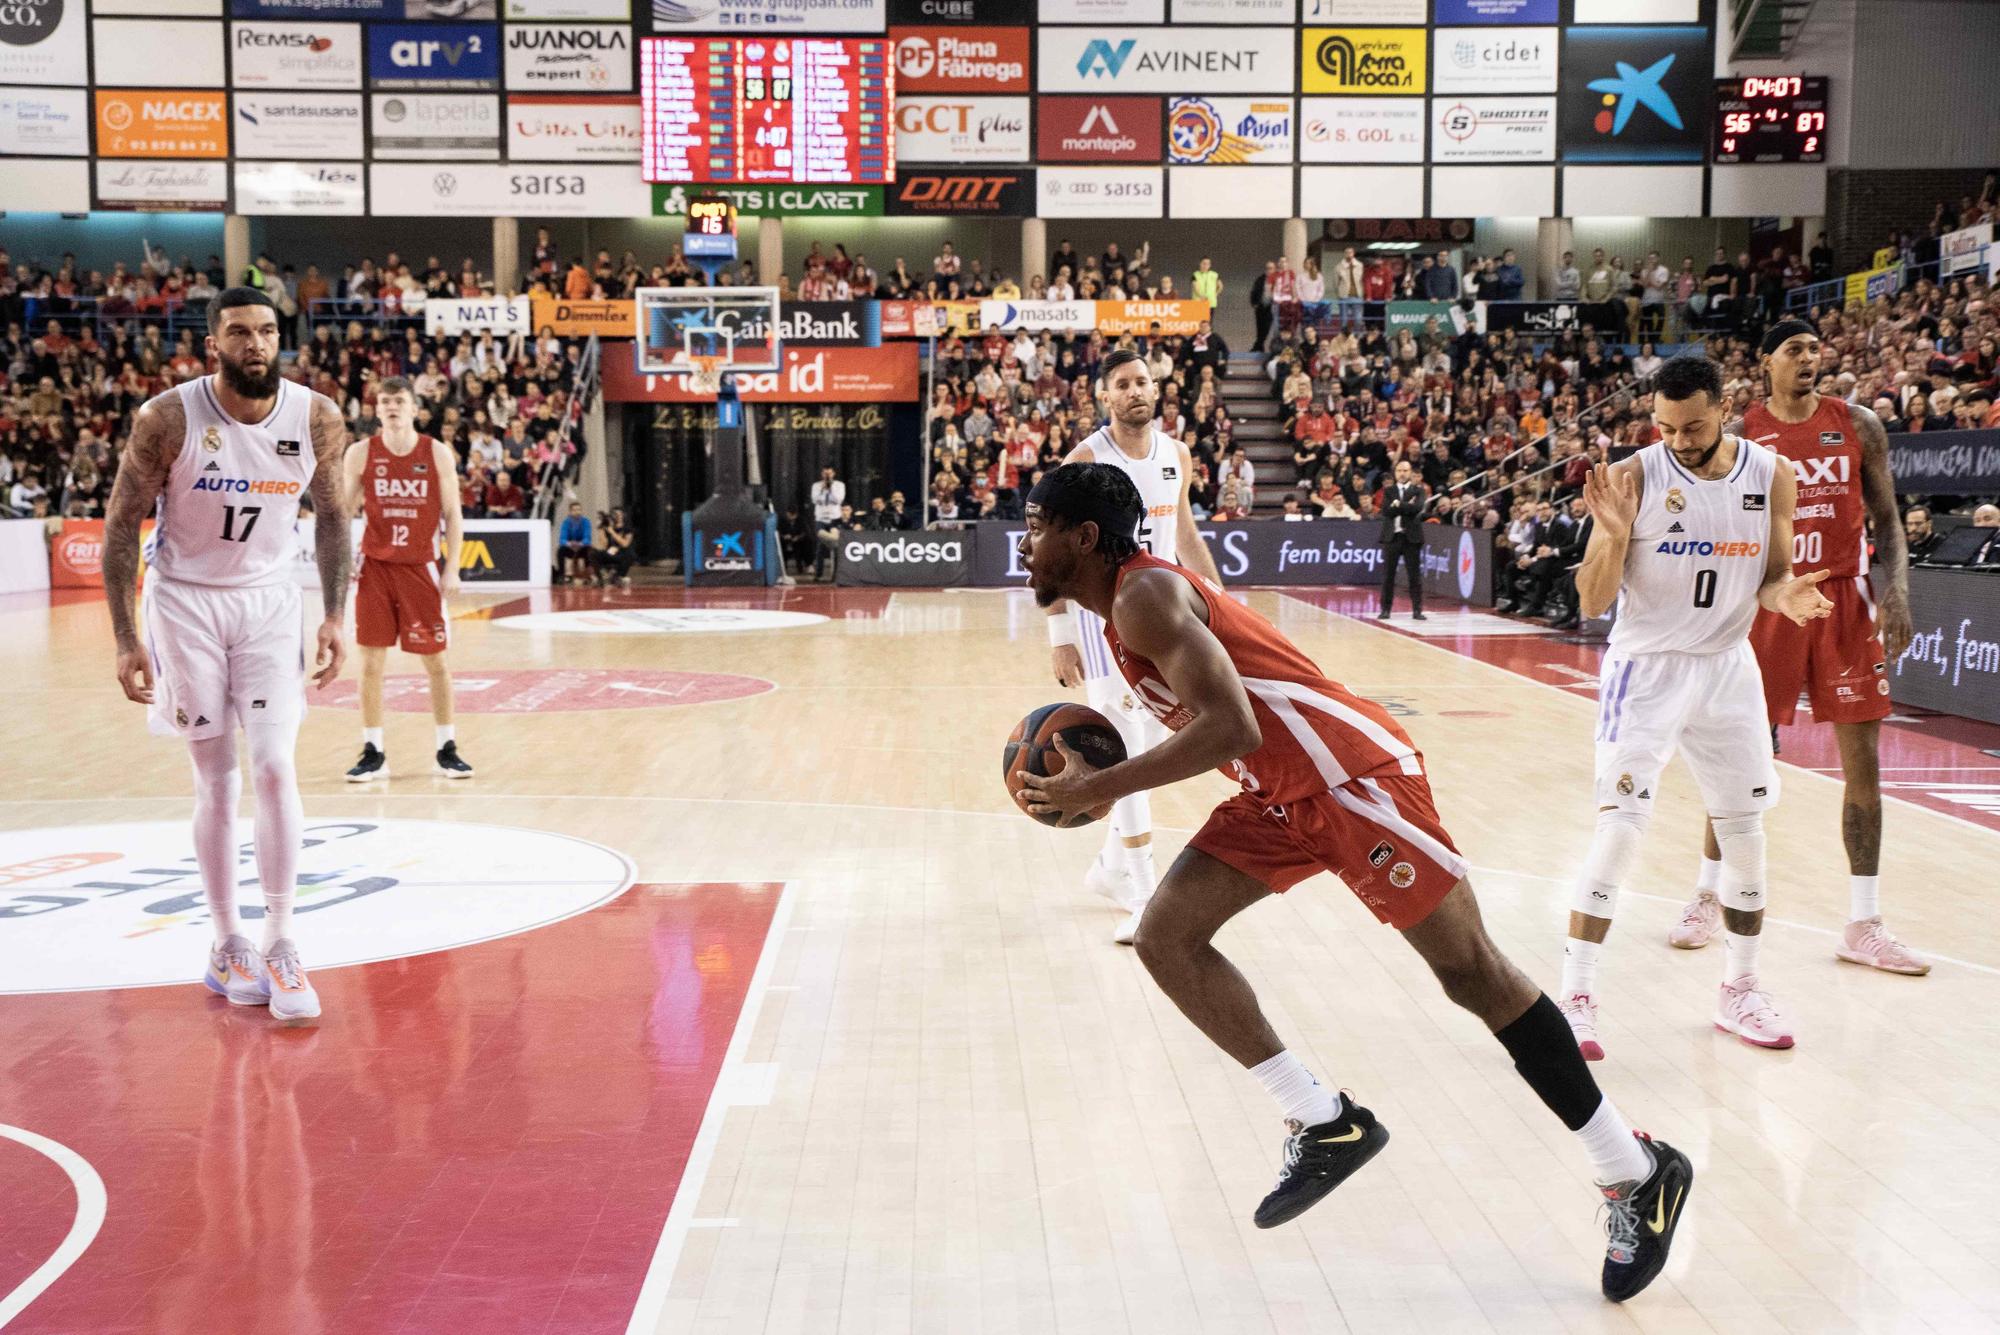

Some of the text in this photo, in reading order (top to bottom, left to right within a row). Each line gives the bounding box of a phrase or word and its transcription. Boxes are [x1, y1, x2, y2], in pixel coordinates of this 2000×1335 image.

[921, 1, 975, 15] CUBE
[237, 29, 321, 50] REMSA
[509, 30, 626, 49] JUANOLA
[938, 37, 998, 58] Plana
[1483, 40, 1540, 61] cidet
[938, 58, 1023, 83] Fábrega
[1136, 51, 1259, 72] AVINENT
[526, 70, 581, 81] expert
[1742, 78, 1802, 98] 04:07
[142, 101, 222, 121] NACEX
[264, 106, 359, 118] santasusana
[1480, 110, 1549, 119] SHOOTER
[896, 104, 1022, 142] GCT plus
[1724, 113, 1752, 133] 56
[1796, 112, 1825, 133] 87
[1062, 135, 1137, 154] montepio
[1357, 129, 1394, 142] GOL
[1723, 136, 1818, 153] 4 2
[511, 175, 585, 195] sarsa
[900, 176, 1017, 201] DMT
[1104, 183, 1153, 196] sarsa
[779, 191, 868, 210] CLARET
[702, 215, 723, 234] 16
[1020, 307, 1079, 321] masats
[1124, 302, 1181, 317] KIBUC
[1100, 318, 1147, 332] Albert
[789, 351, 825, 393] id
[192, 477, 301, 495] AUTOHERO
[374, 479, 428, 497] BAXI
[220, 505, 262, 542] 17
[391, 524, 409, 546] 12
[844, 538, 962, 564] endesa
[1279, 540, 1321, 573] fem
[1656, 541, 1761, 557] AUTOHERO
[1693, 569, 1718, 608] 0
[1373, 850, 1389, 866] acb
